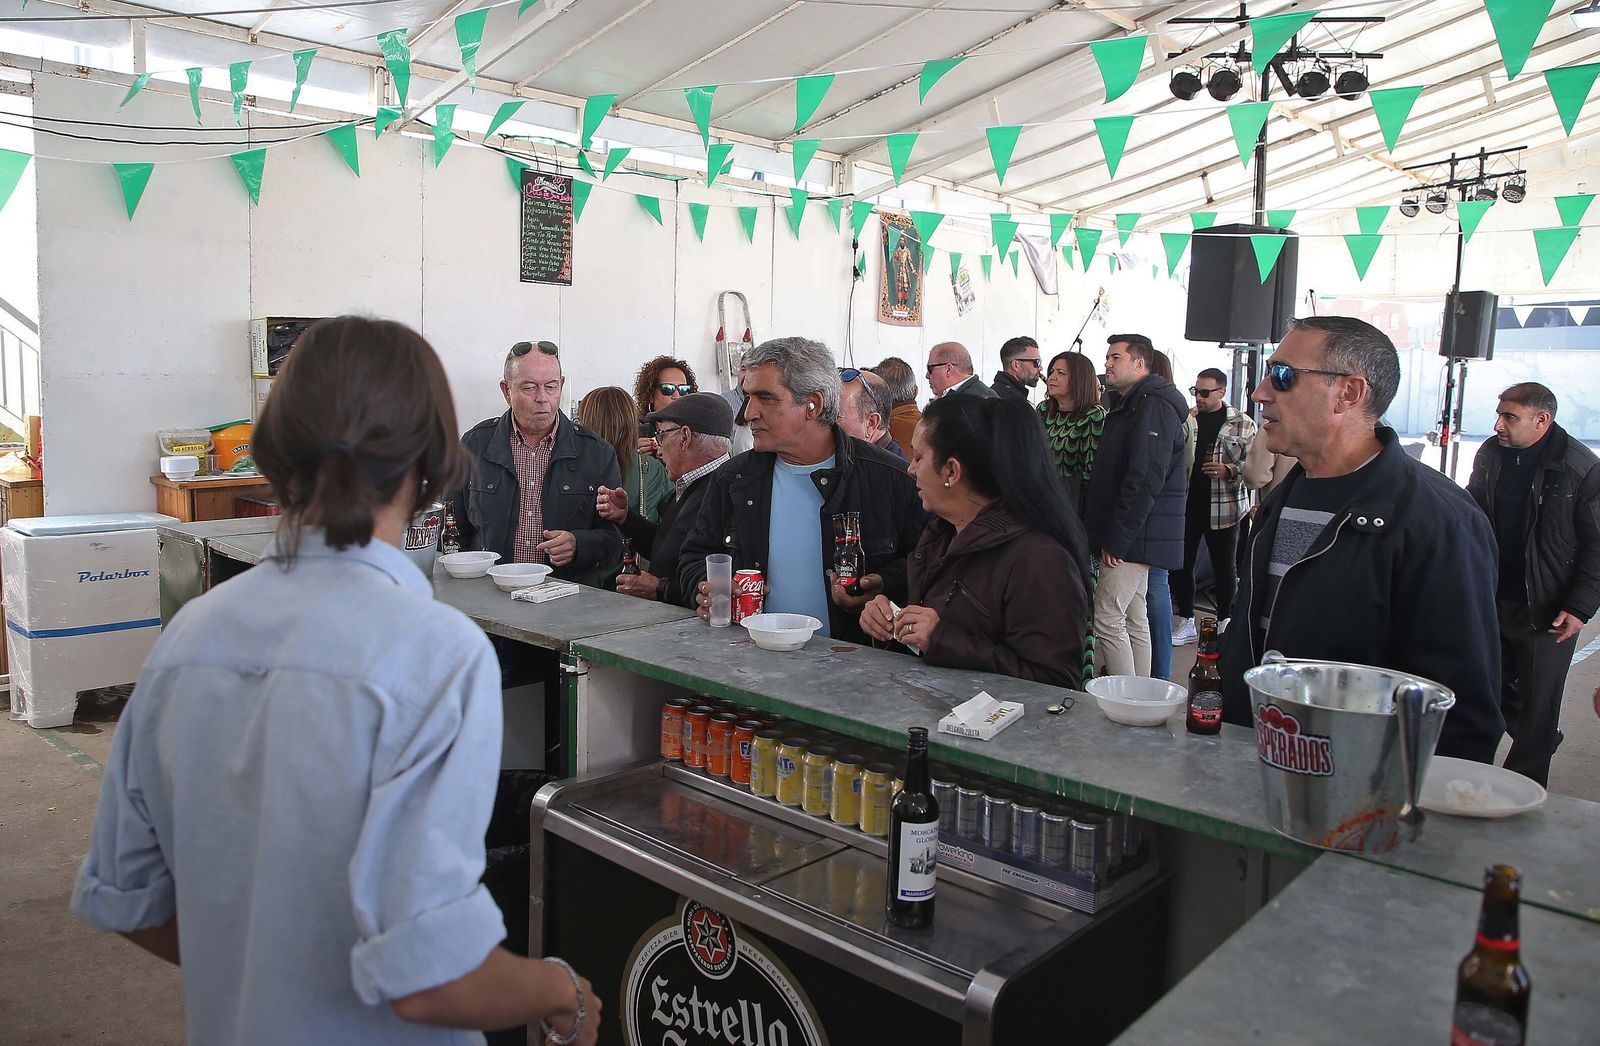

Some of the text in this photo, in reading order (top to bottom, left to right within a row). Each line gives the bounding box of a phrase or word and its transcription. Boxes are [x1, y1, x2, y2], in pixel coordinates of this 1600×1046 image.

[77, 568, 149, 583] Polarbox
[777, 757, 796, 774] NTA
[1258, 720, 1334, 775] SPERADOS
[910, 826, 938, 836] MOSCAT
[638, 930, 679, 967] CERVEZA BIER
[742, 945, 800, 1007] BEER CERVEJA
[651, 974, 789, 1046] Estrella
